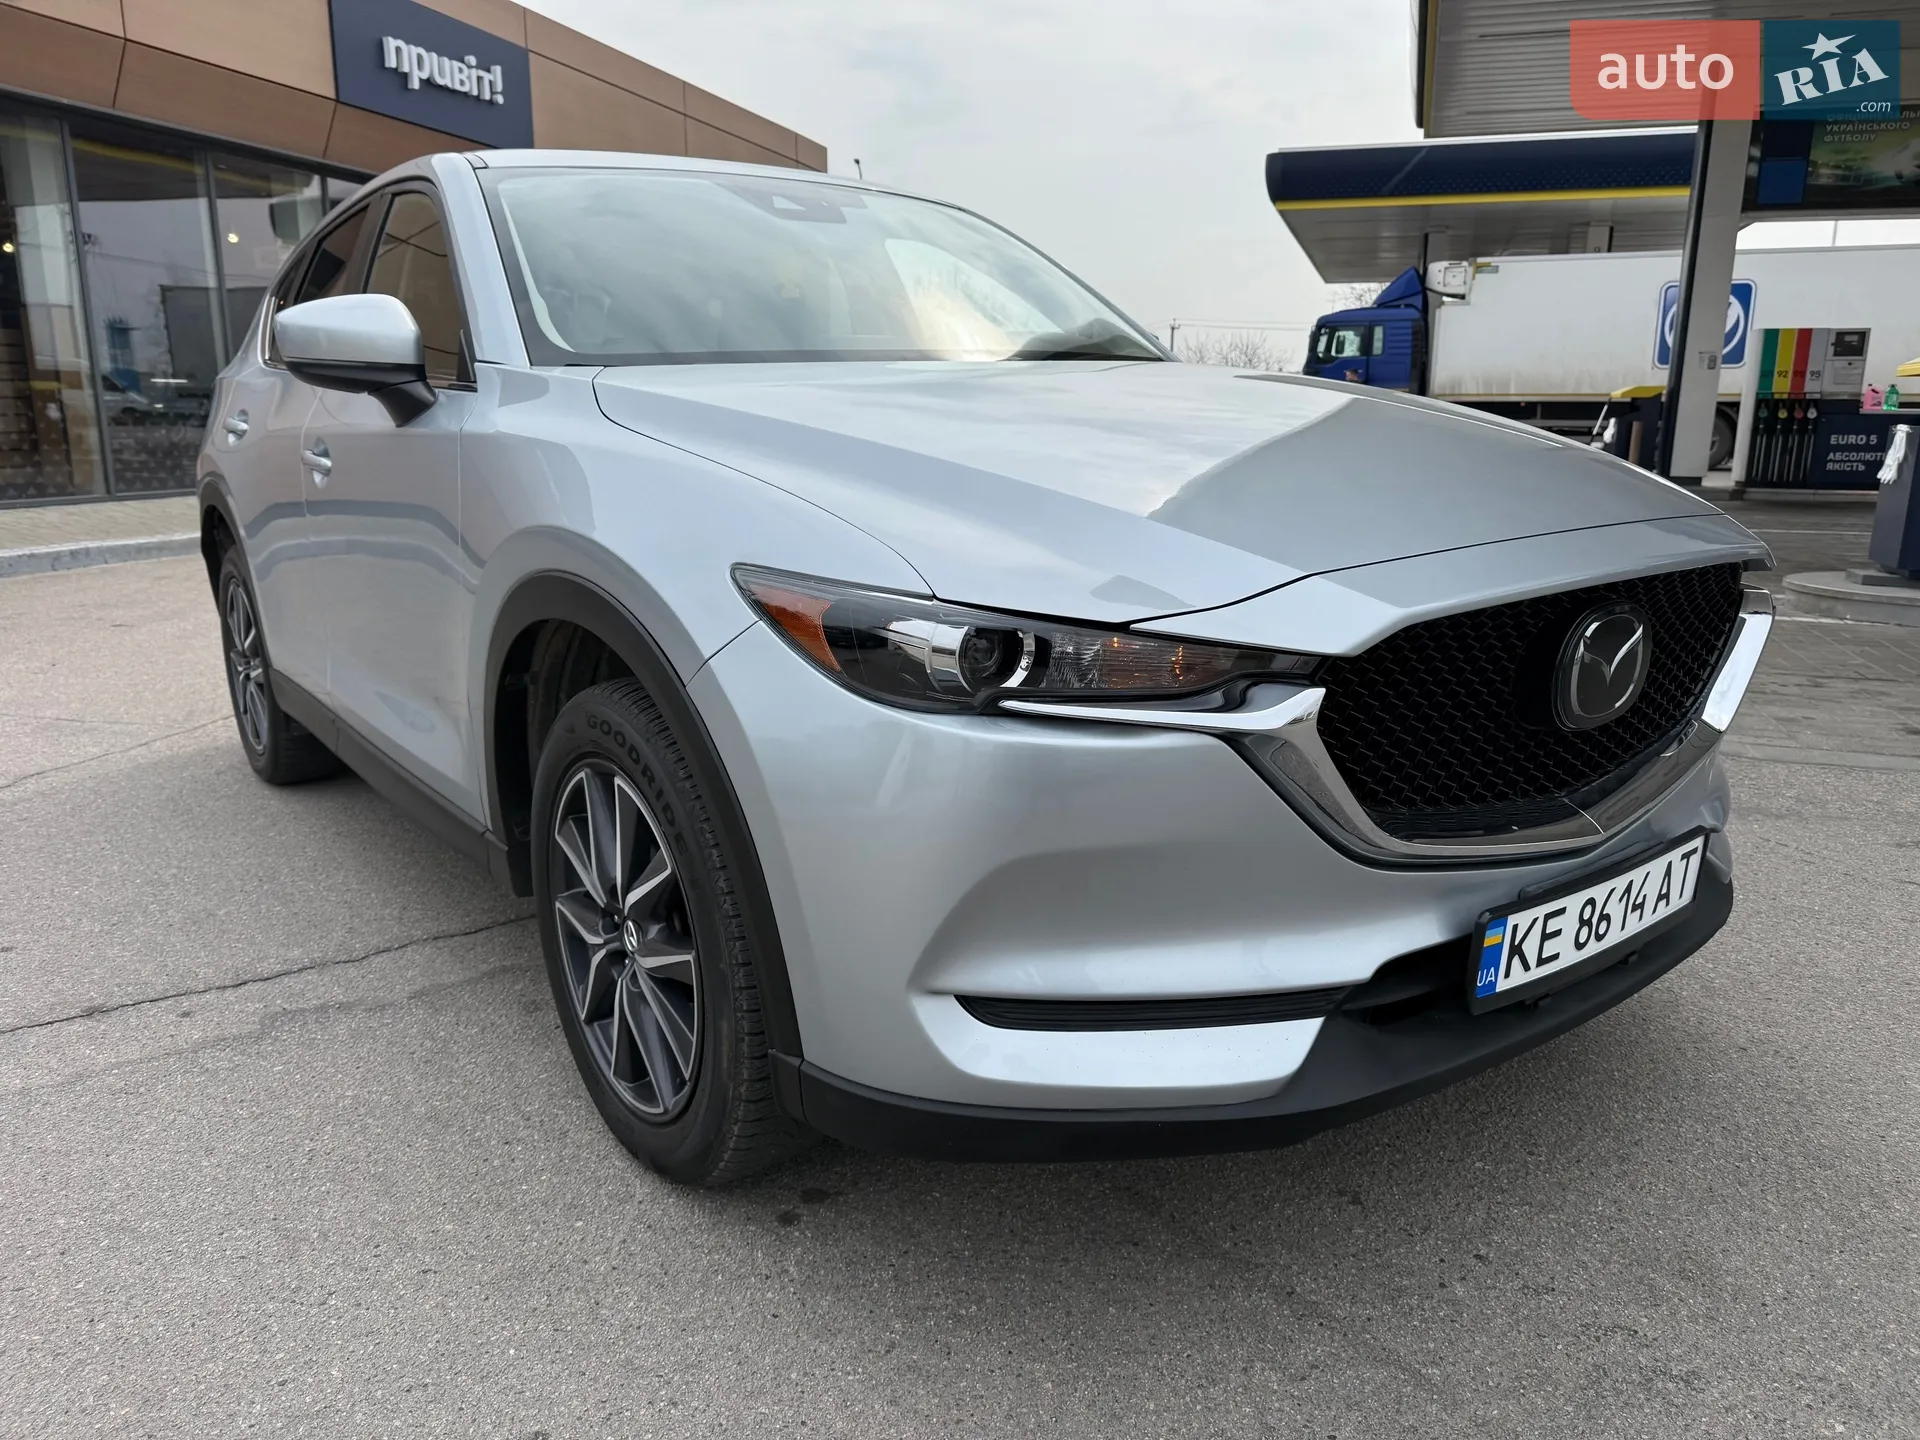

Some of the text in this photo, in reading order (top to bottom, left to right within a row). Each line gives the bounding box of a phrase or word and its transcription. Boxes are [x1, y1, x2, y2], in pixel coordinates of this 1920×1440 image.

[382, 36, 504, 104] привіт!
[1826, 121, 1910, 132] УКРАЇНСЬКОГО
[1824, 133, 1876, 143] ФУТБОЛУ
[1810, 370, 1821, 378] 95
[1830, 435, 1878, 445] EURO 5
[1826, 462, 1865, 471] ЯКІСТЬ
[587, 714, 690, 855] GOODRIDE
[1574, 871, 1650, 951] 8614
[1652, 846, 1699, 917] AT
[1477, 967, 1496, 987] UA
